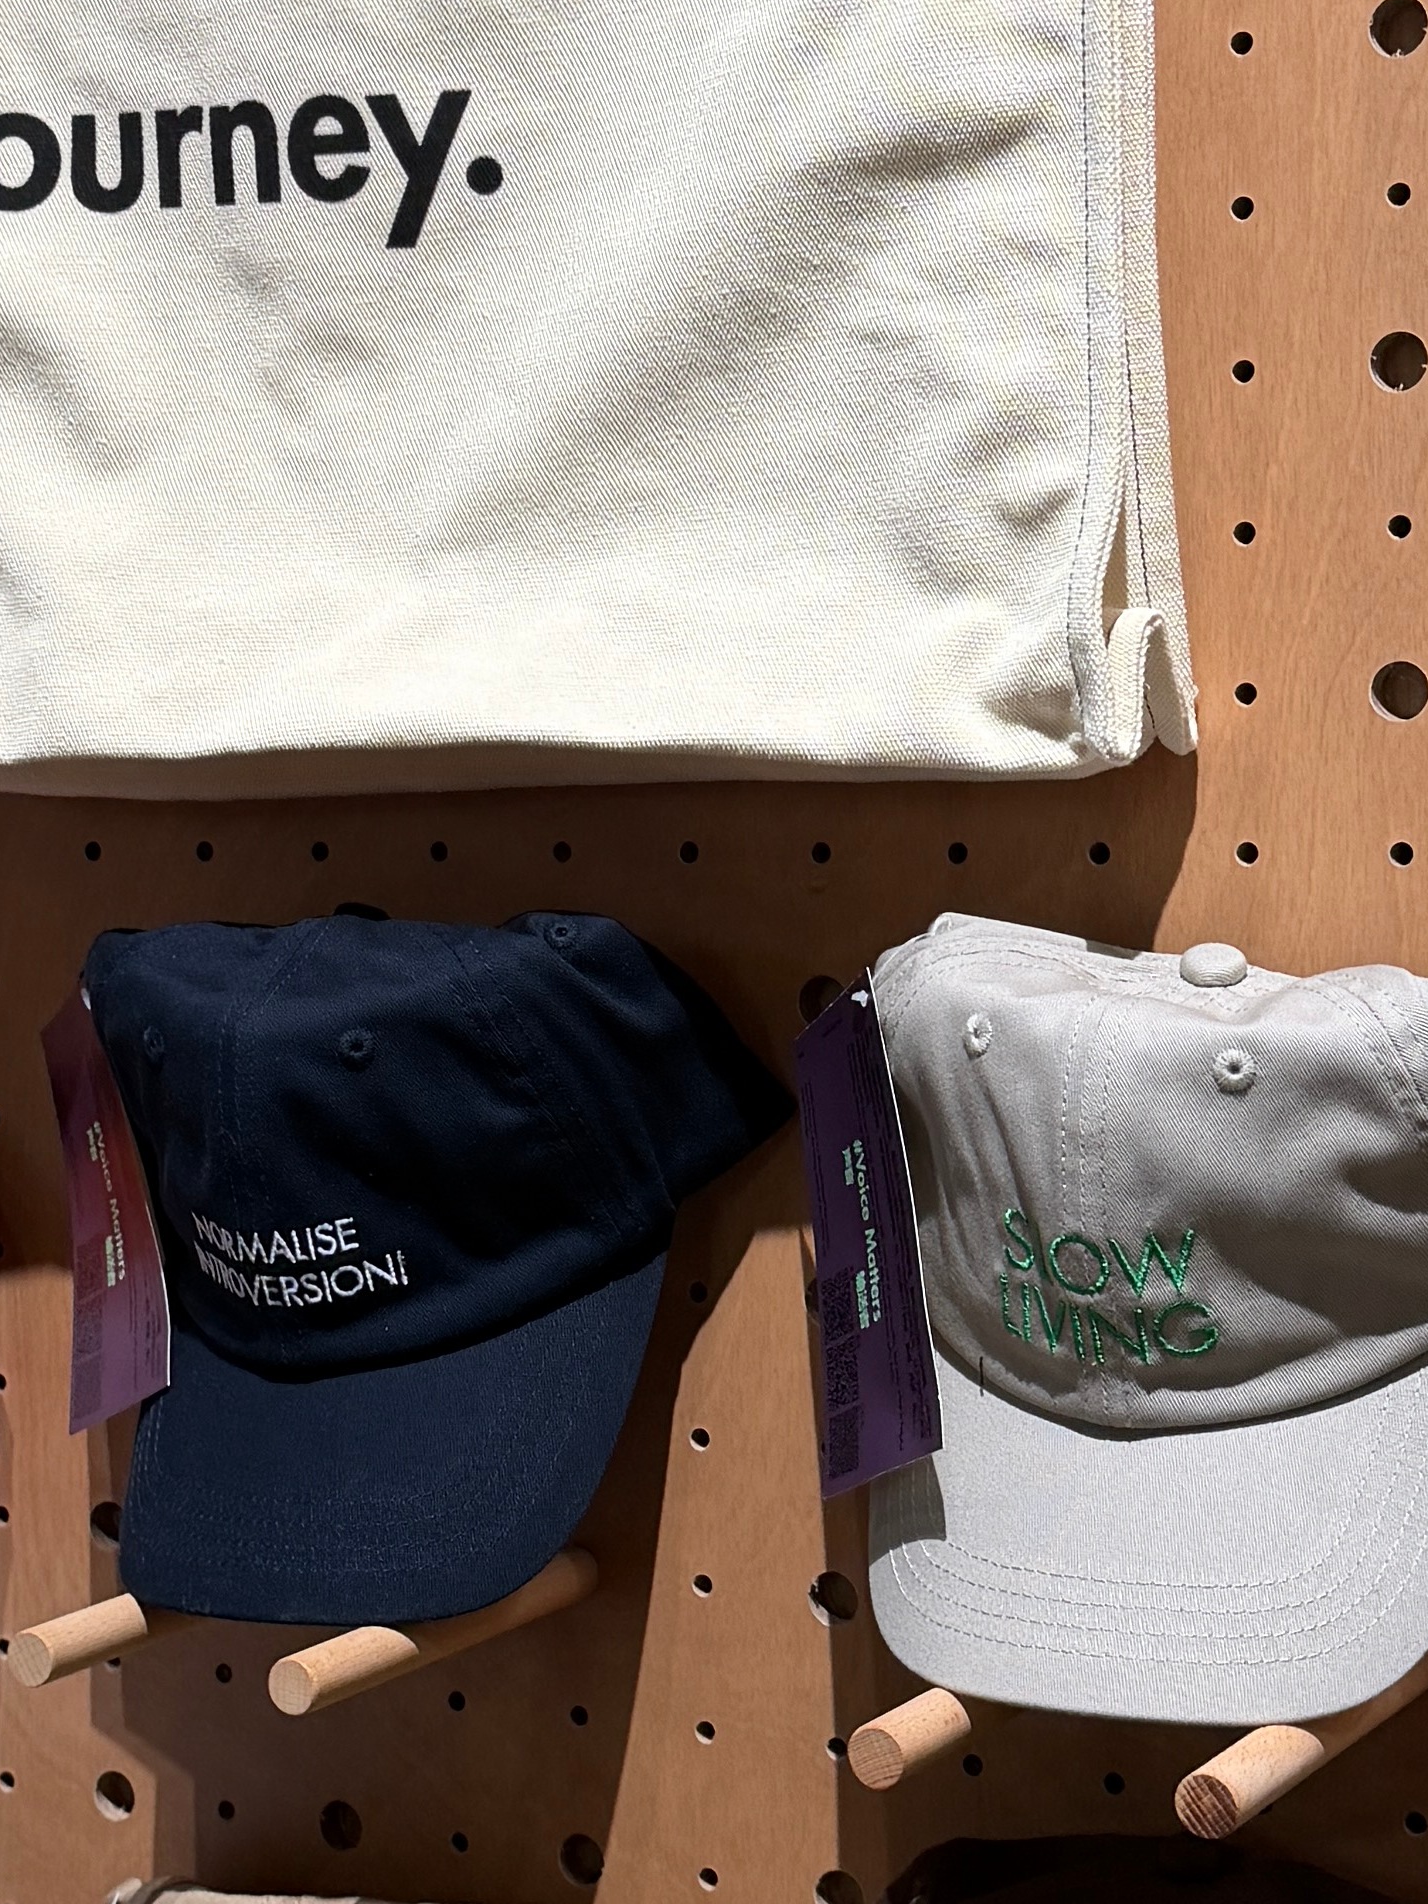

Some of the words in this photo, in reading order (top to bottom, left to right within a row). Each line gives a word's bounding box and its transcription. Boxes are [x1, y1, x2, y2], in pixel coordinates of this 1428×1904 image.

[109, 1198, 127, 1280] Matters
[191, 1211, 360, 1265] NORMALISE
[851, 1139, 871, 1222] #Voice
[865, 1228, 884, 1323] Matters
[1000, 1271, 1219, 1365] LIVING
